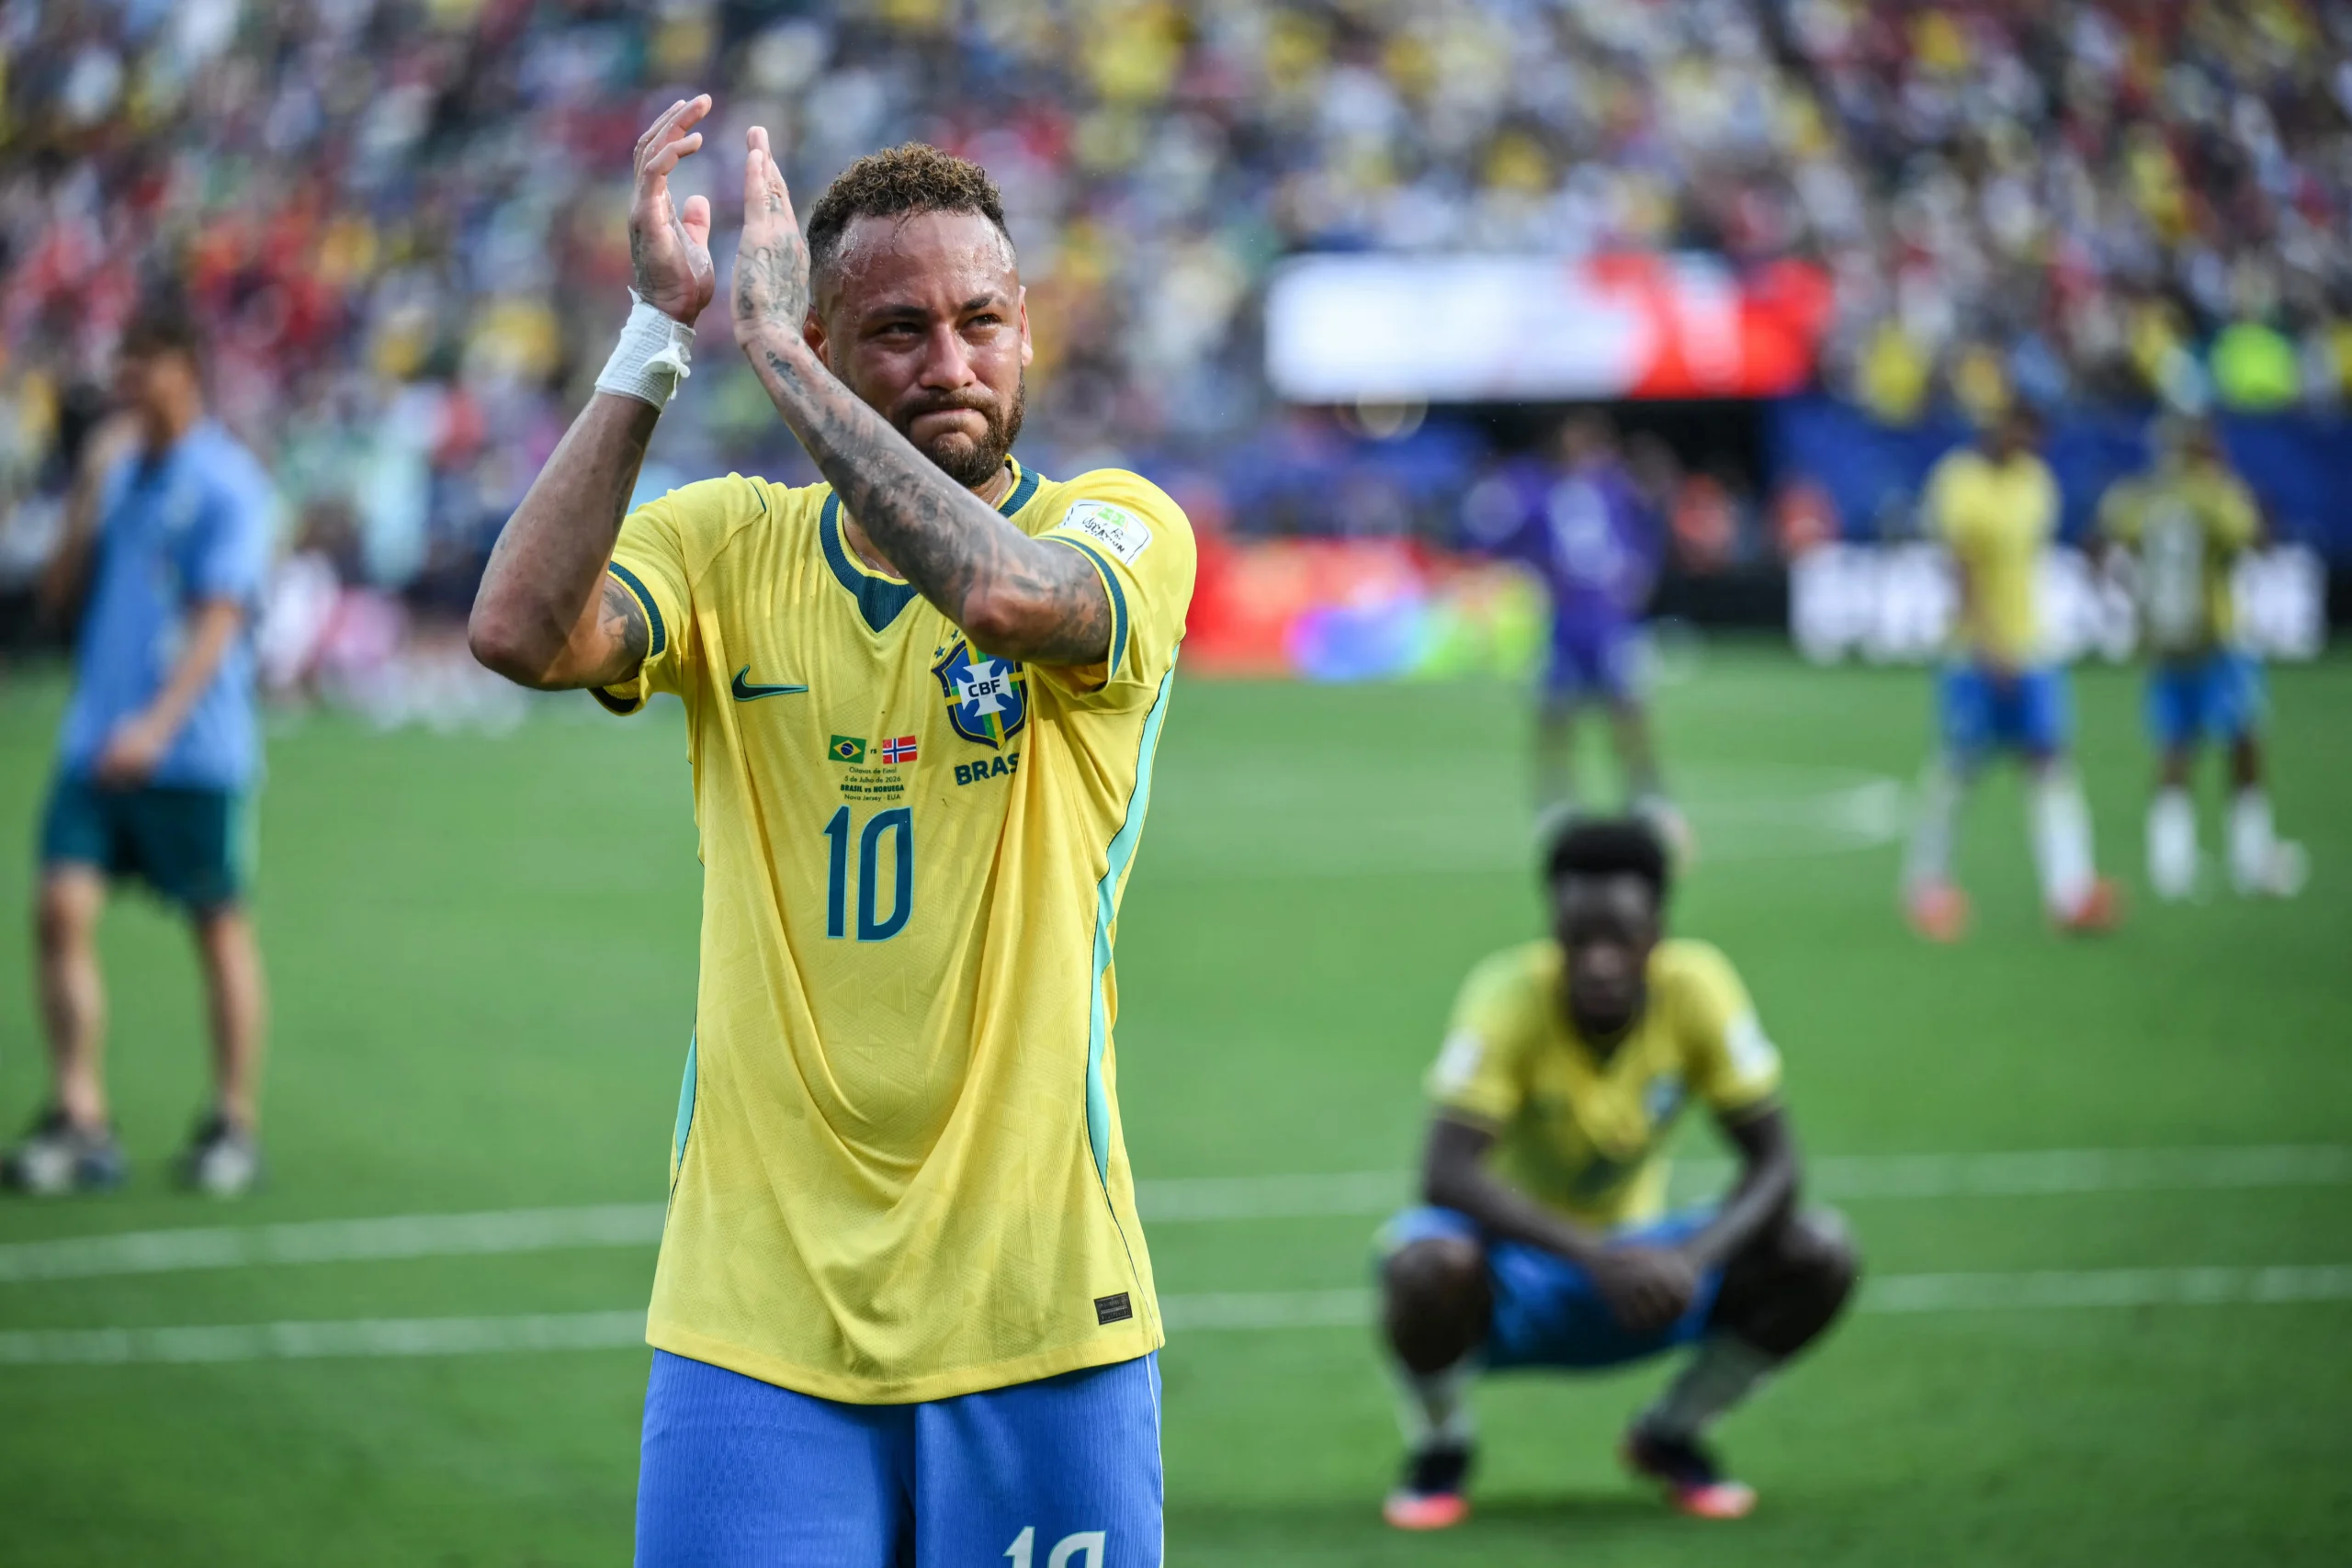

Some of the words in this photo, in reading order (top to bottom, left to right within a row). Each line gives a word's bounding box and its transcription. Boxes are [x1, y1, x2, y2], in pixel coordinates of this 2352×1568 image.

[967, 679, 1001, 698] CBF
[849, 766, 872, 774] Oitavos
[882, 766, 898, 774] Final
[954, 752, 1020, 786] BRAS
[841, 784, 863, 793] BRASIL
[873, 784, 905, 793] NORUEGA
[823, 804, 913, 943] 10
